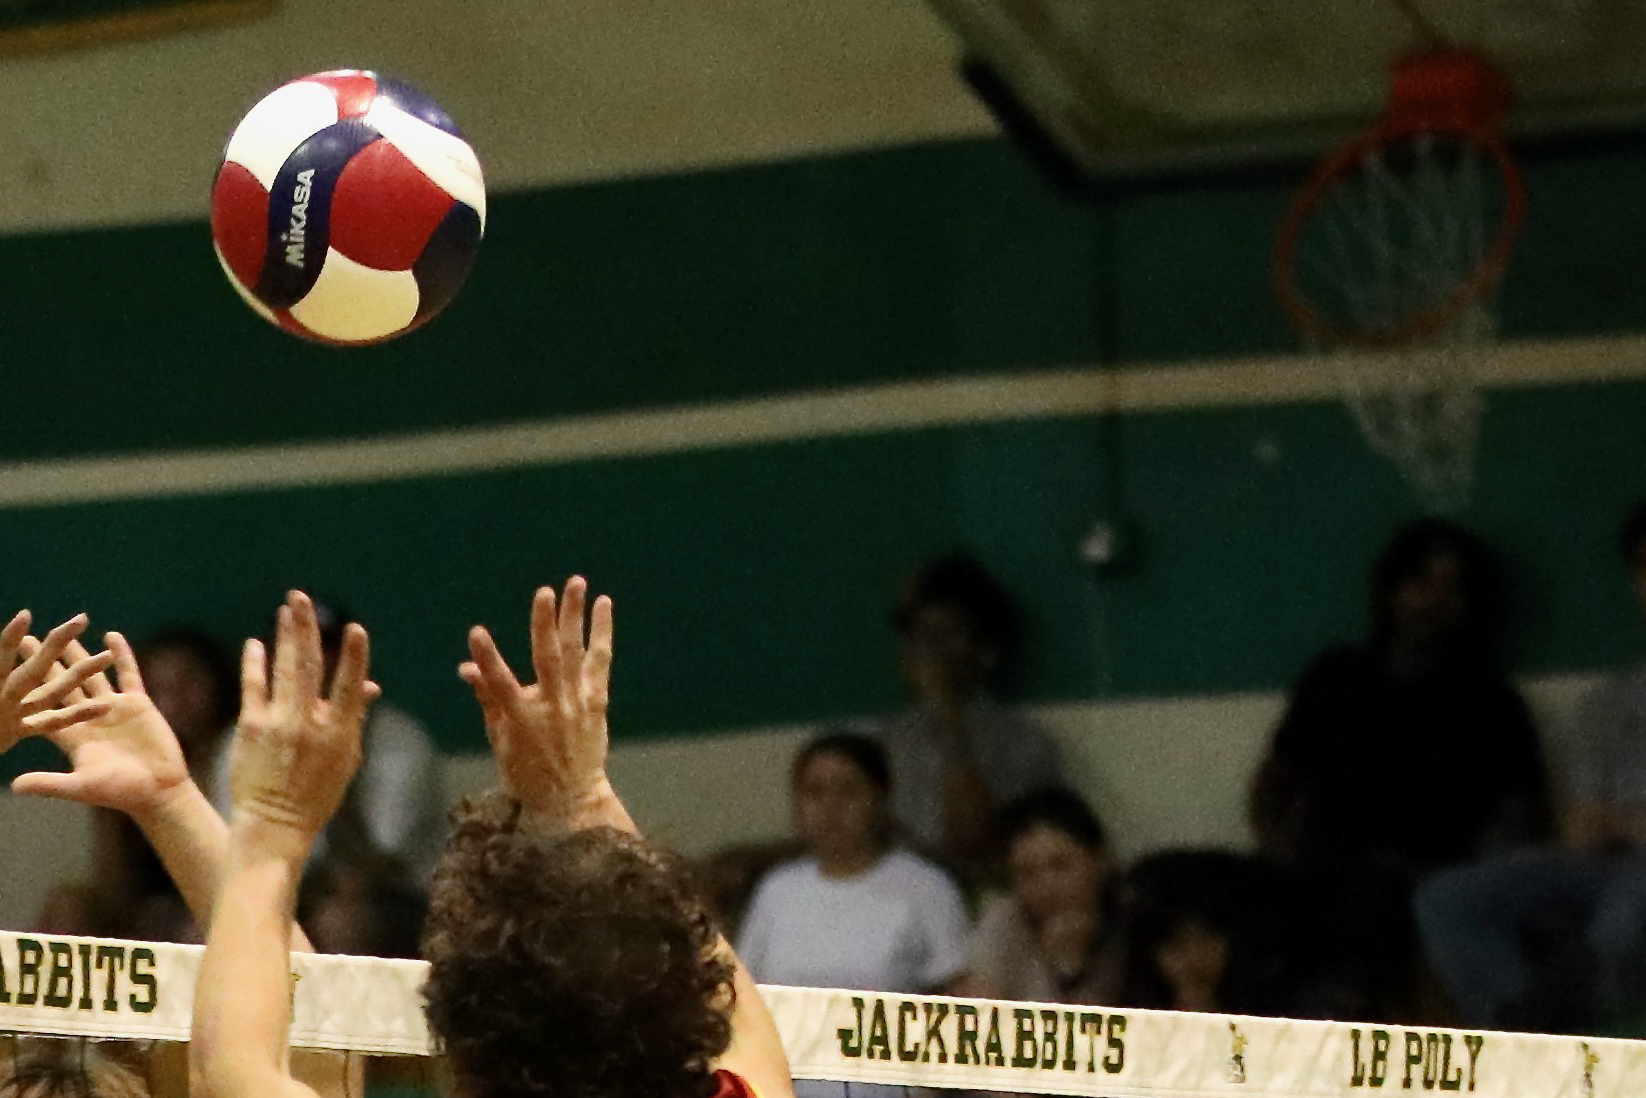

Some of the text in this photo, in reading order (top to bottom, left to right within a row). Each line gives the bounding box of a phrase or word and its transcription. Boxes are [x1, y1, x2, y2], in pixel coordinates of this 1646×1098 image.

[836, 997, 1127, 1074] JACKRABBITS
[1350, 1028, 1484, 1092] LB POLY
